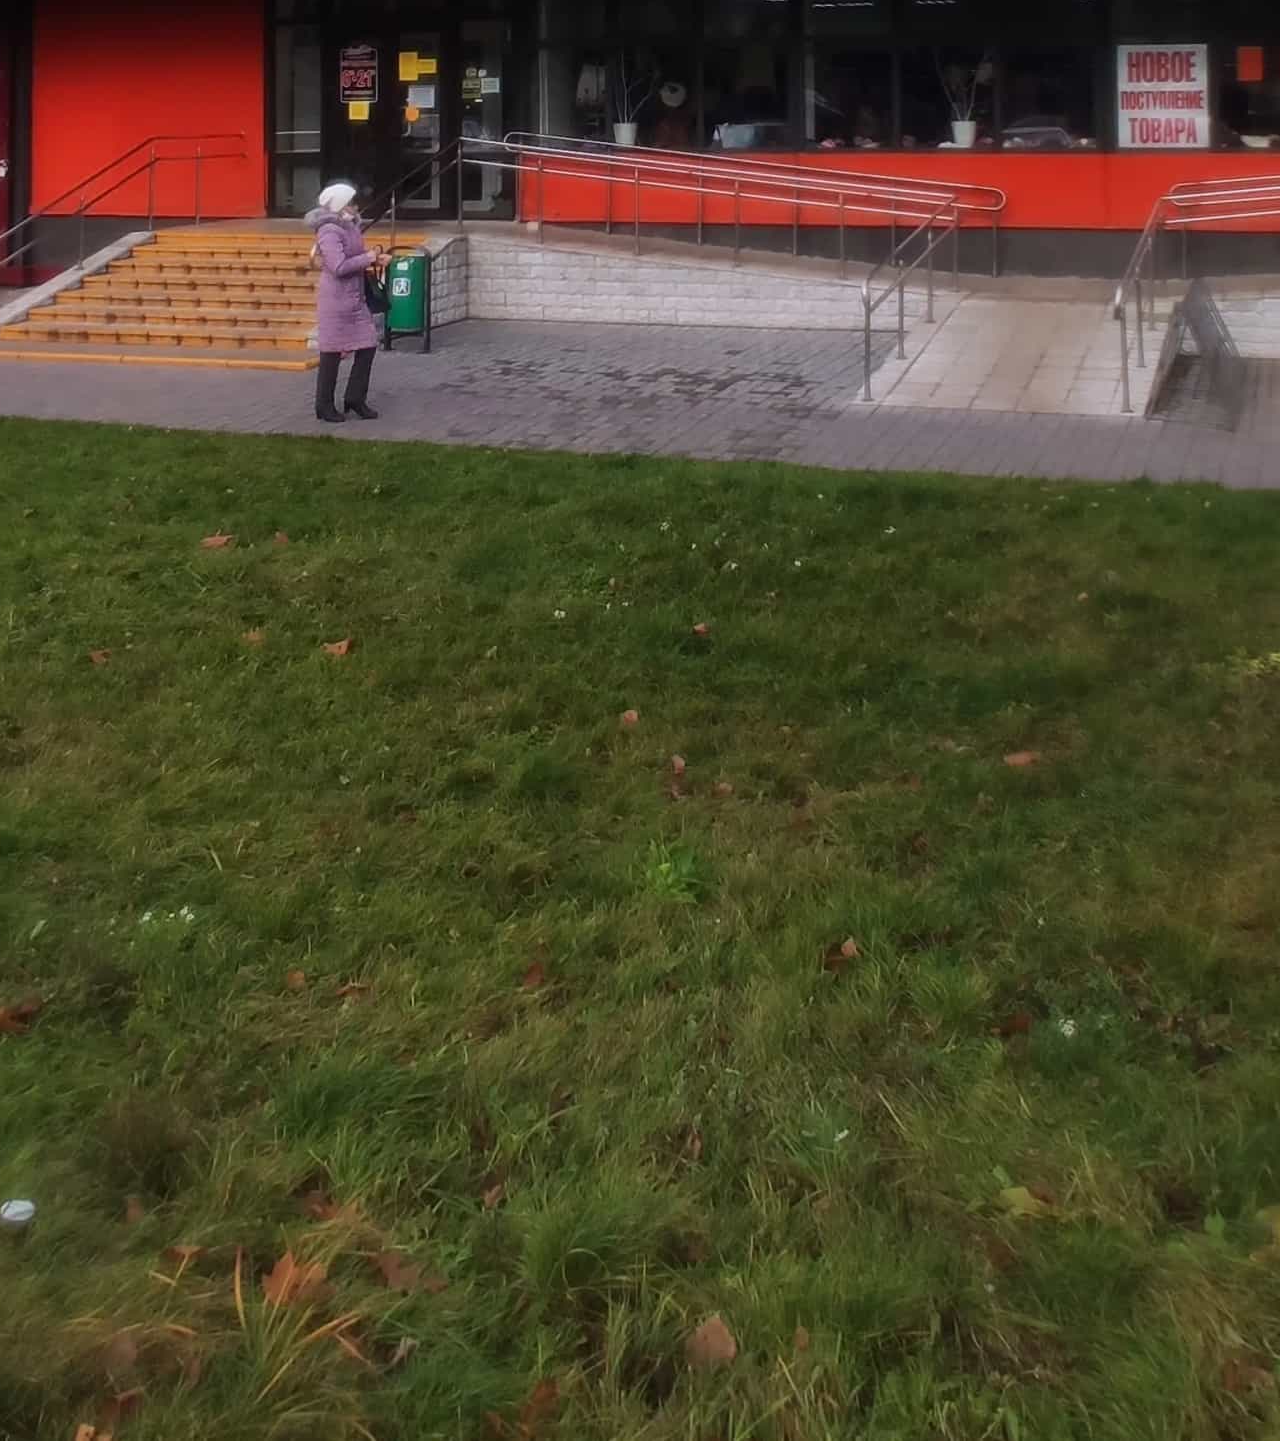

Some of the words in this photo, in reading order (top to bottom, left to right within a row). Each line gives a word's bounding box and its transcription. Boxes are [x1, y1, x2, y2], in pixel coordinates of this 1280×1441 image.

[1127, 51, 1197, 83] НОВОЕ
[1120, 90, 1204, 111] ПОСТУПЛЕНИЕ
[1128, 117, 1198, 145] ТОВАРА
